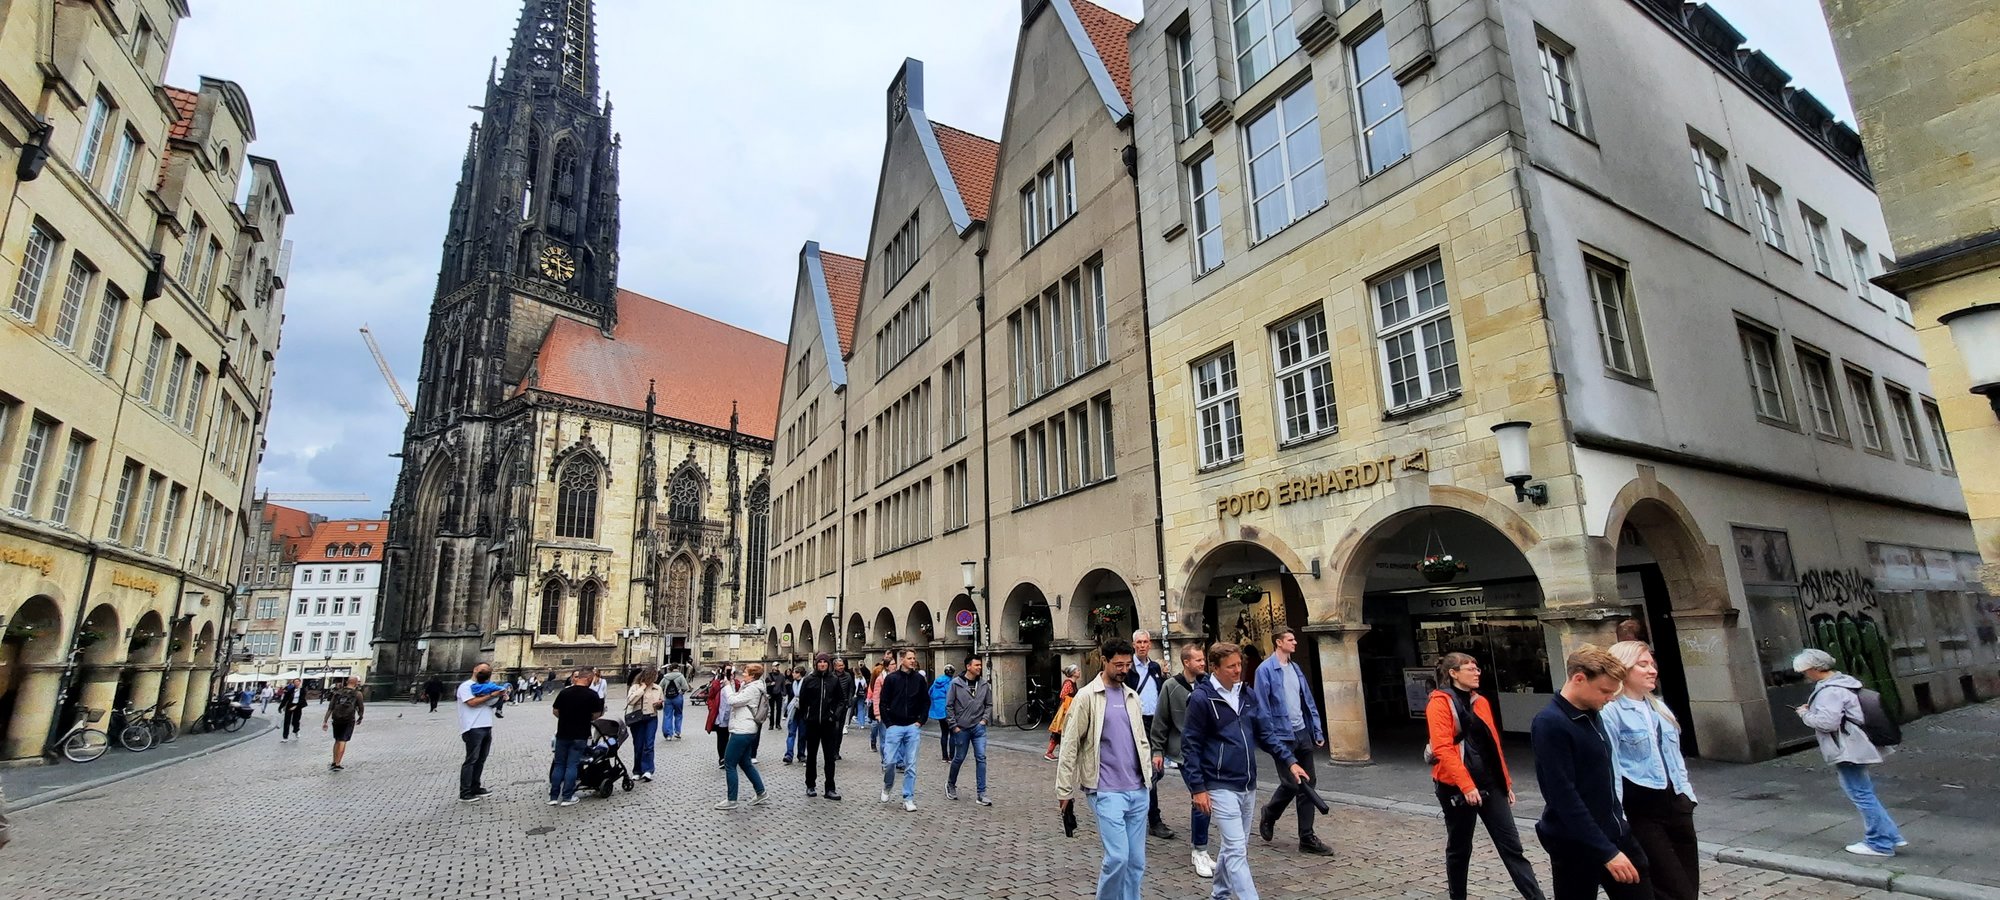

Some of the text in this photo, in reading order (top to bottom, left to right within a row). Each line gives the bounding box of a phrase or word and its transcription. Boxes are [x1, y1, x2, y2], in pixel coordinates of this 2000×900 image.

[1216, 455, 1396, 519] FOTO ERHARDT
[1430, 598, 1456, 608] FOTO
